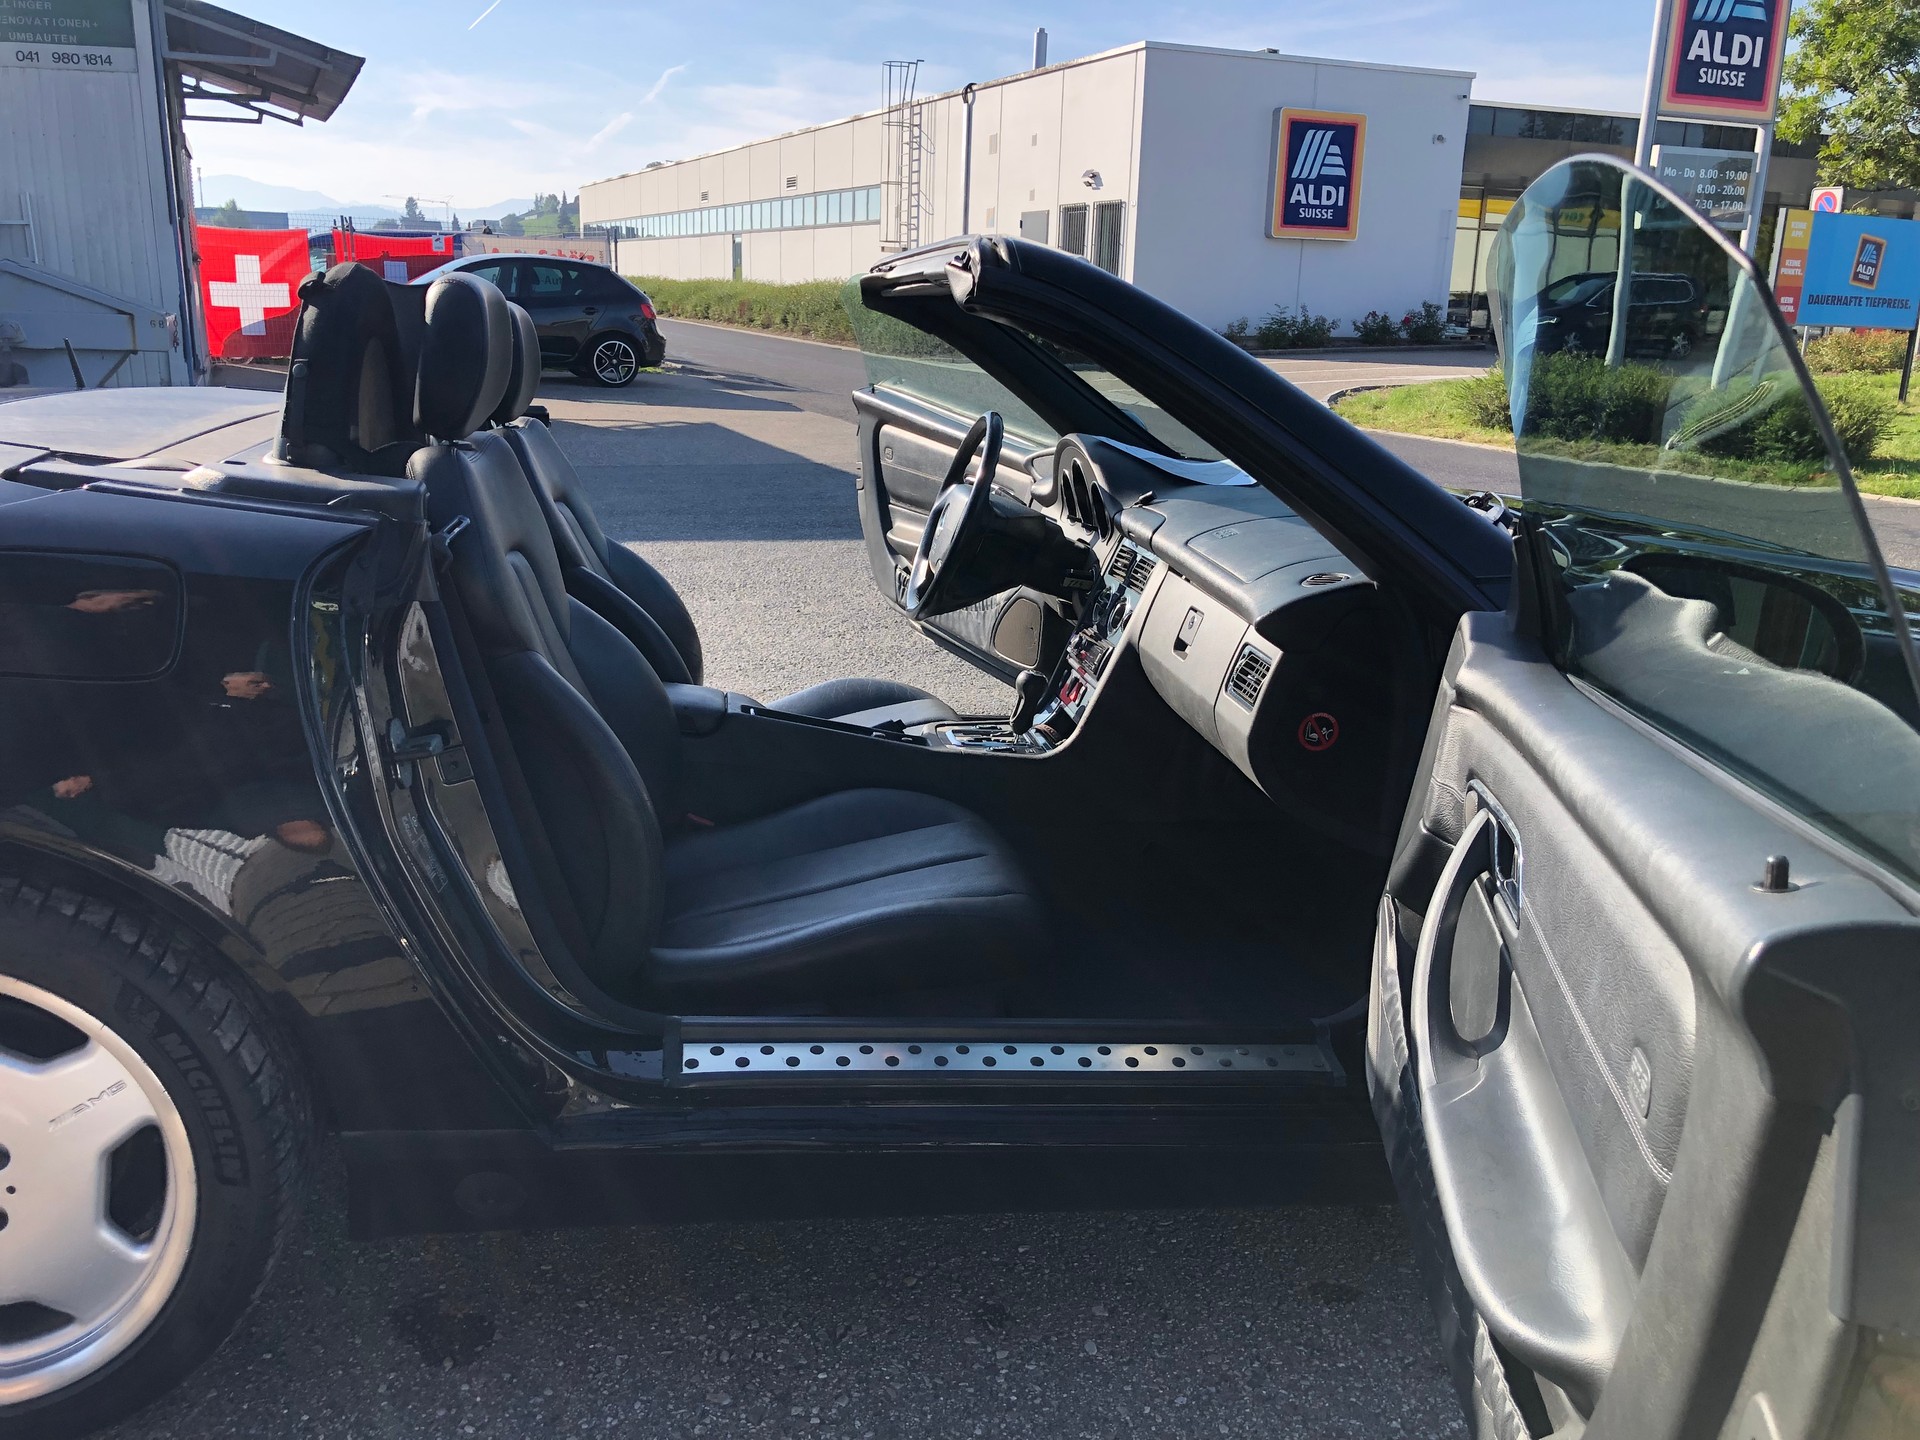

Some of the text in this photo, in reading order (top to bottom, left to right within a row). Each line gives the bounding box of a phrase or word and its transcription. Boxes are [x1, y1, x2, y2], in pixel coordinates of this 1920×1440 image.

[0, 0, 52, 10] LINGER
[0, 15, 90, 28] ENOVATIONEN
[8, 32, 78, 43] UMBAUTEN
[1687, 29, 1764, 68] ALDI
[15, 50, 113, 66] 041 980 1814
[1698, 67, 1746, 87] SUISSE
[1663, 167, 1677, 177] Mo
[1683, 167, 1696, 178] Do
[1699, 168, 1719, 179] 8.00
[1725, 170, 1748, 181] 19.00
[1290, 183, 1345, 207] ALDI
[1696, 184, 1716, 195] 8.00
[1720, 200, 1744, 211] 17.00
[1298, 207, 1334, 220] SUISSE
[1856, 264, 1875, 276] ALDI
[1808, 294, 1911, 310] DAUERHAFTE TIEFPREISE.
[158, 1031, 243, 1180] MICHELIN
